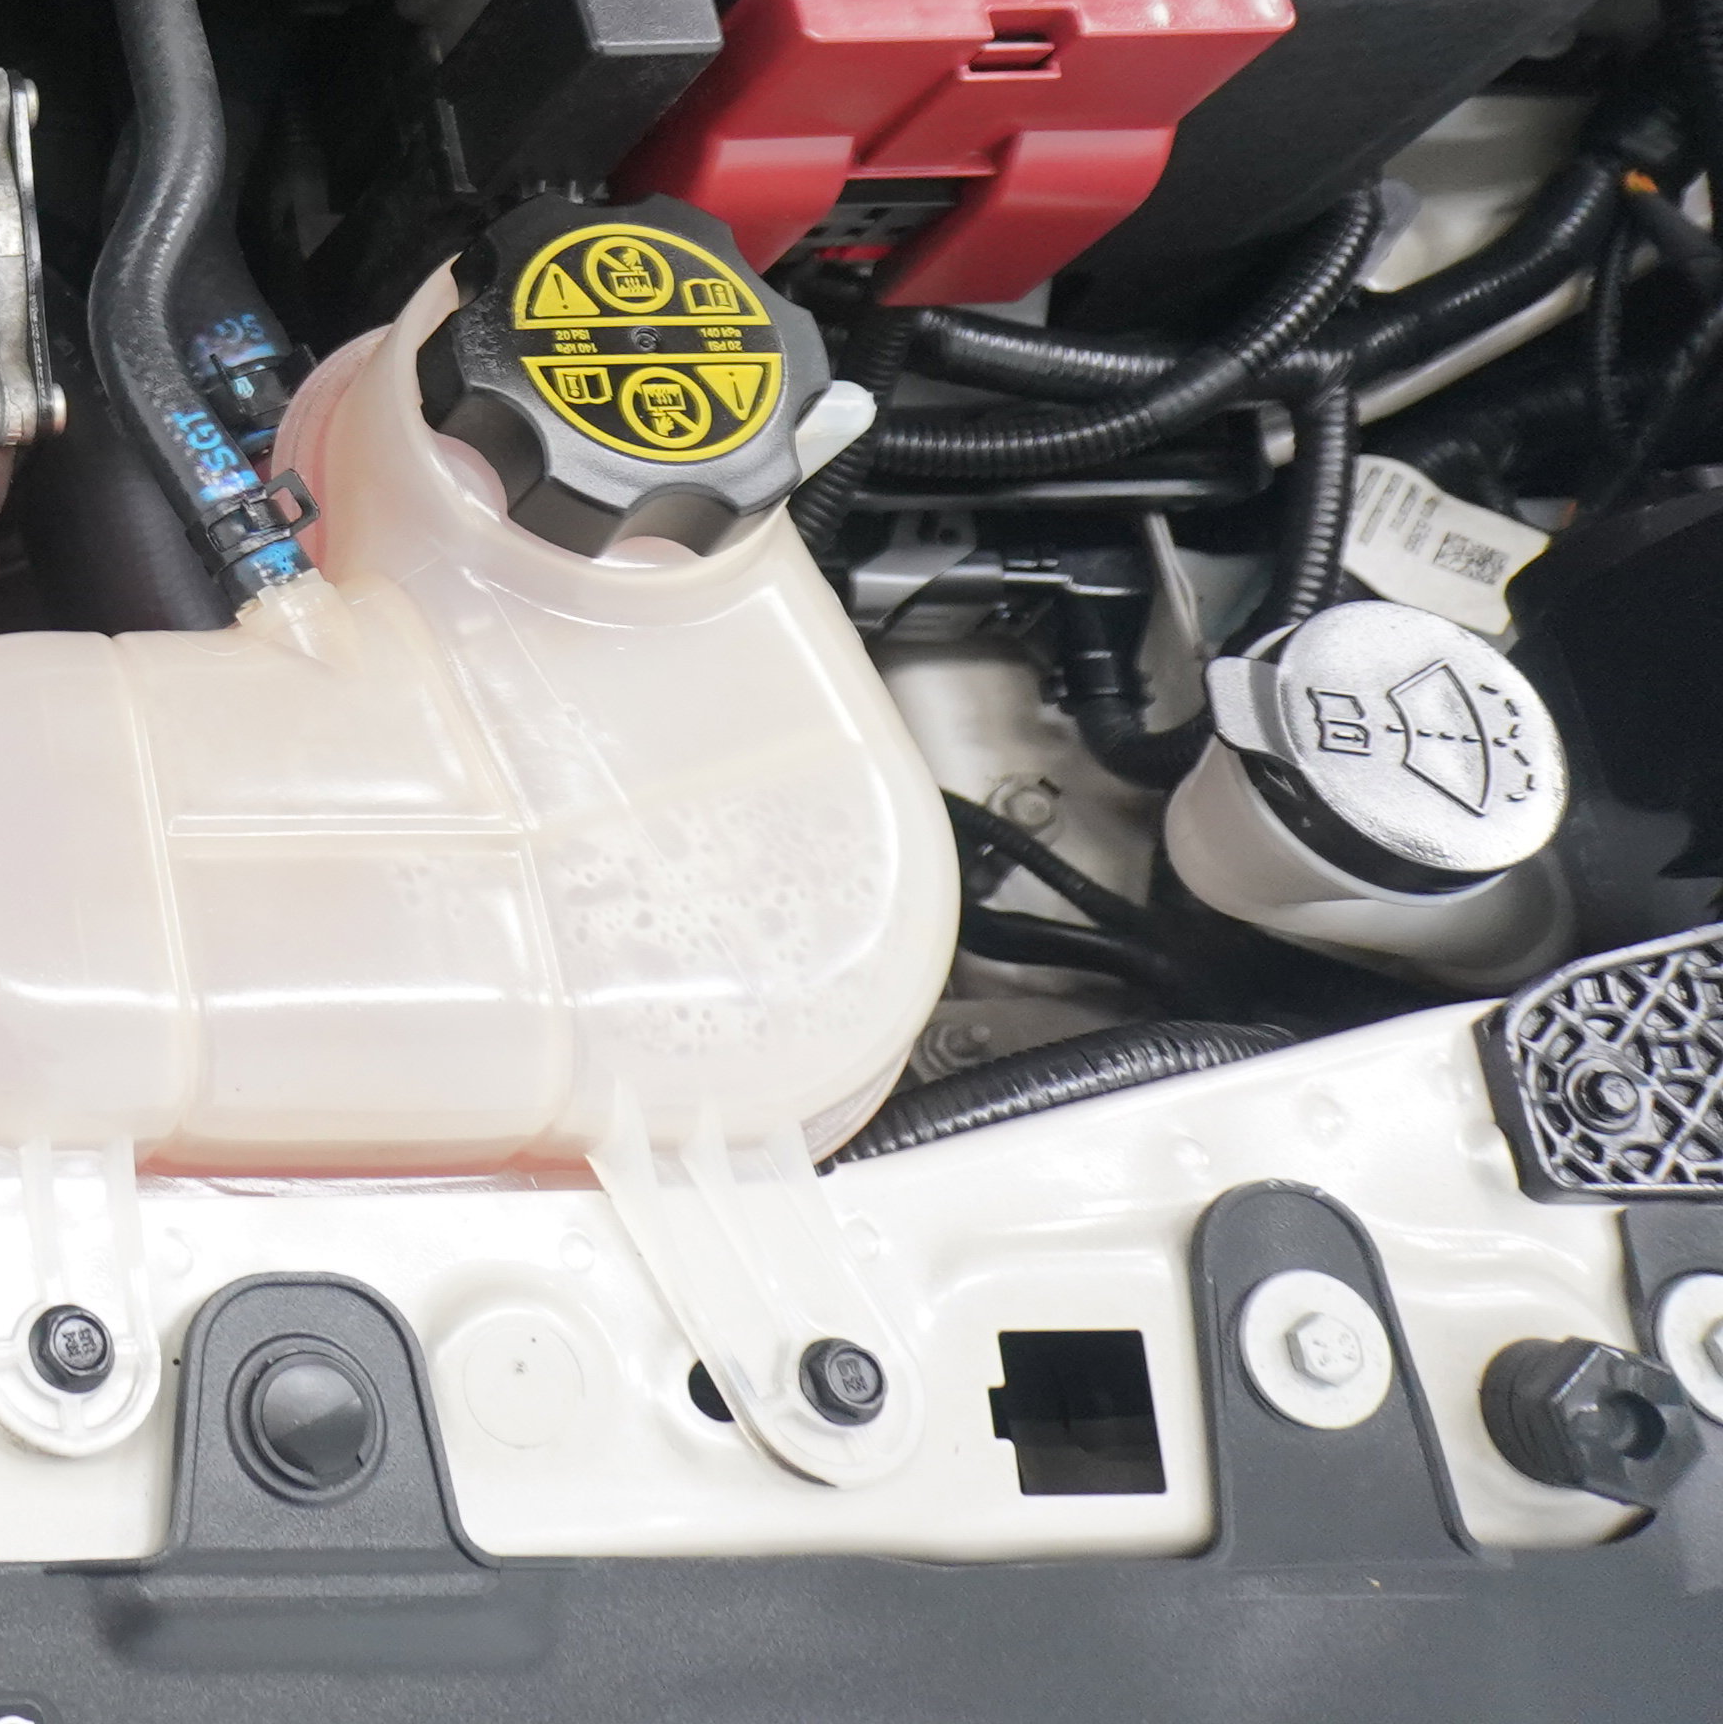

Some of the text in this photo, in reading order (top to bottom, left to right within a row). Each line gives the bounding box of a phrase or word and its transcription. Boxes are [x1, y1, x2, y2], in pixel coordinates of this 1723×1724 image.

[556, 329, 591, 341] 20 PSI
[700, 327, 720, 339] 140
[577, 342, 598, 354] 140
[708, 340, 743, 352] 20 PSI
